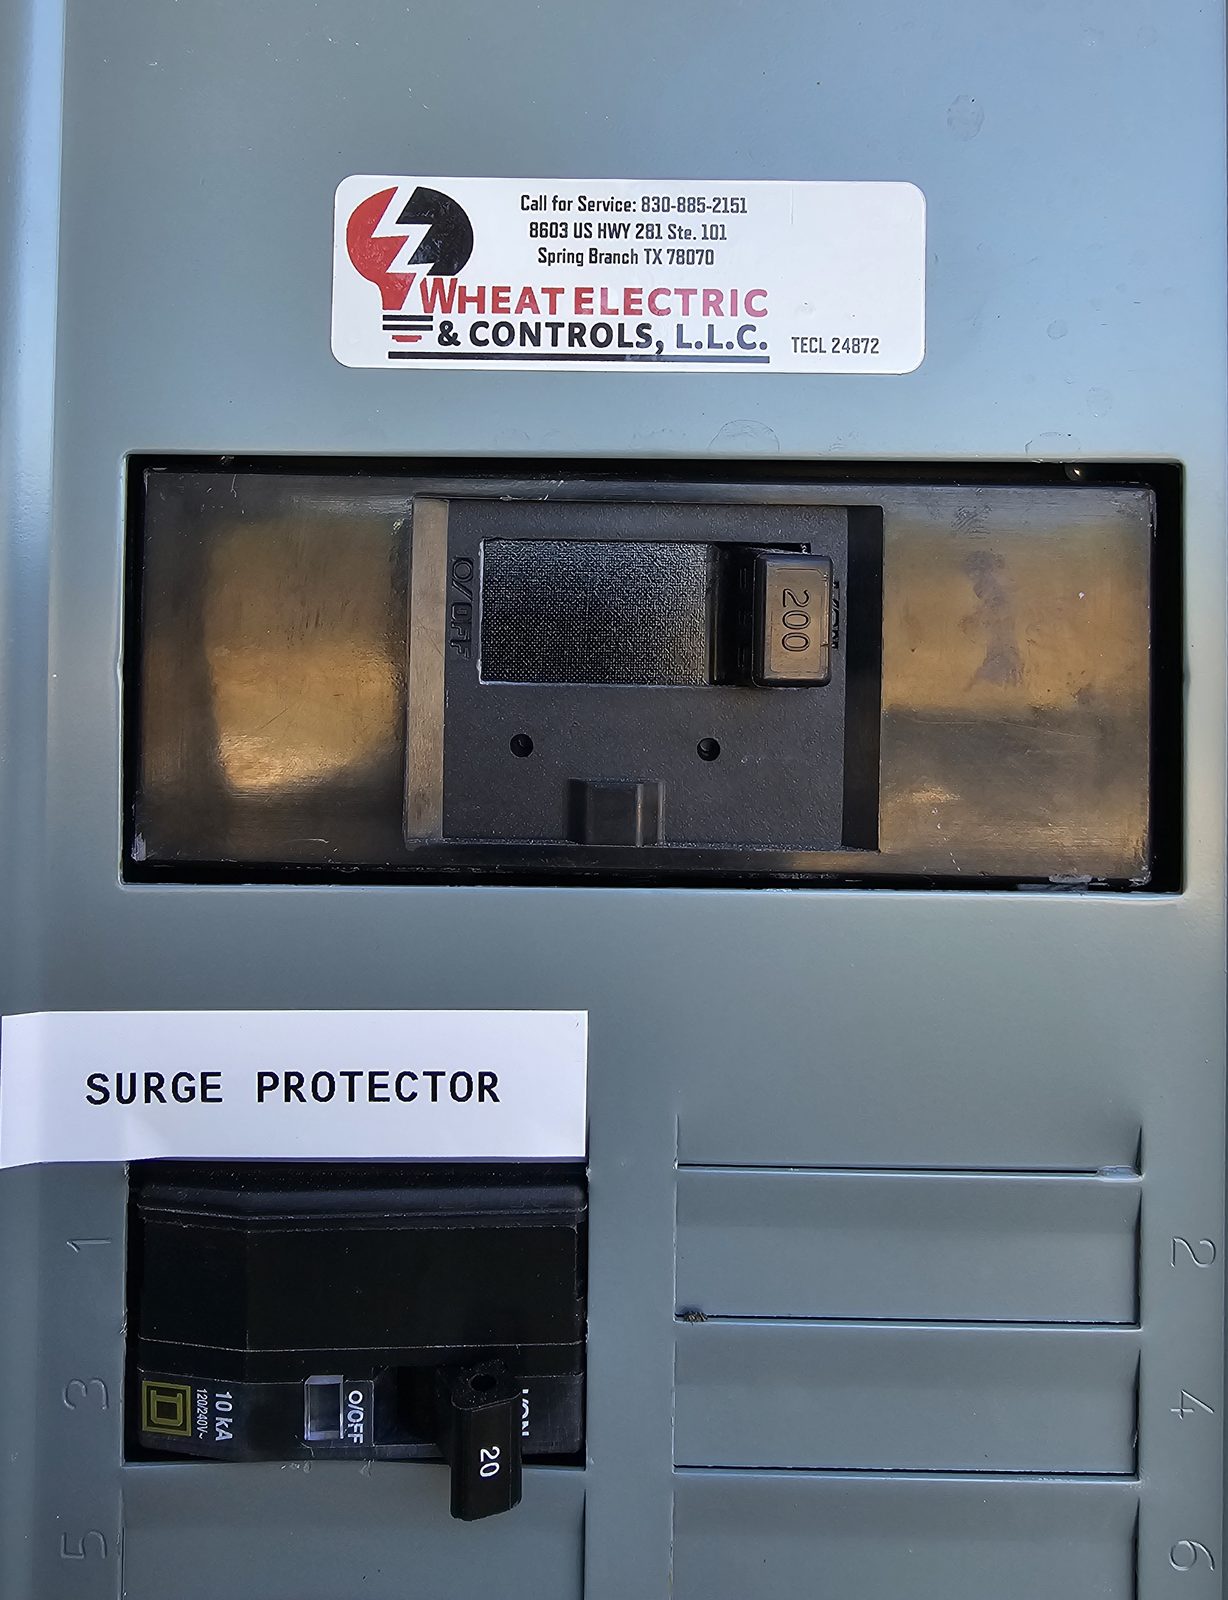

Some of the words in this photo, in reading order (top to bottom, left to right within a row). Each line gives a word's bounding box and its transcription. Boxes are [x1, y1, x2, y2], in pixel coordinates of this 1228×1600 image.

[520, 195, 547, 212] Call
[552, 195, 573, 212] for
[578, 195, 637, 213] Service:
[641, 196, 748, 214] 830-885-2151
[529, 221, 568, 239] 8603
[573, 222, 593, 239] US
[598, 222, 631, 239] HWY
[635, 222, 663, 240] 281
[667, 223, 697, 241] Ste.
[701, 223, 728, 241] 101
[538, 246, 584, 267] Spring
[588, 247, 639, 265] Branch
[644, 248, 663, 265] TX
[666, 248, 715, 266] 78070
[419, 277, 565, 315] WHEAT
[574, 286, 769, 318] ELECTRIC
[437, 320, 462, 347] &
[469, 320, 665, 355] CONTROLS,
[676, 323, 768, 351] L.L.C.
[791, 336, 827, 354] TECL
[831, 337, 880, 355] 24872
[782, 588, 811, 652] 200
[86, 1071, 223, 1106] SURGE
[256, 1070, 501, 1104] PROTECTOR
[66, 1237, 112, 1253] 1
[1170, 1237, 1216, 1269] 2
[62, 1378, 109, 1410] 3
[215, 1391, 233, 1412] 10
[1170, 1389, 1215, 1420] 4
[215, 1418, 233, 1442] kA
[346, 1389, 365, 1445] O/OFF
[479, 1445, 501, 1478] 20
[60, 1530, 107, 1559] 5
[1169, 1539, 1216, 1572] 6
